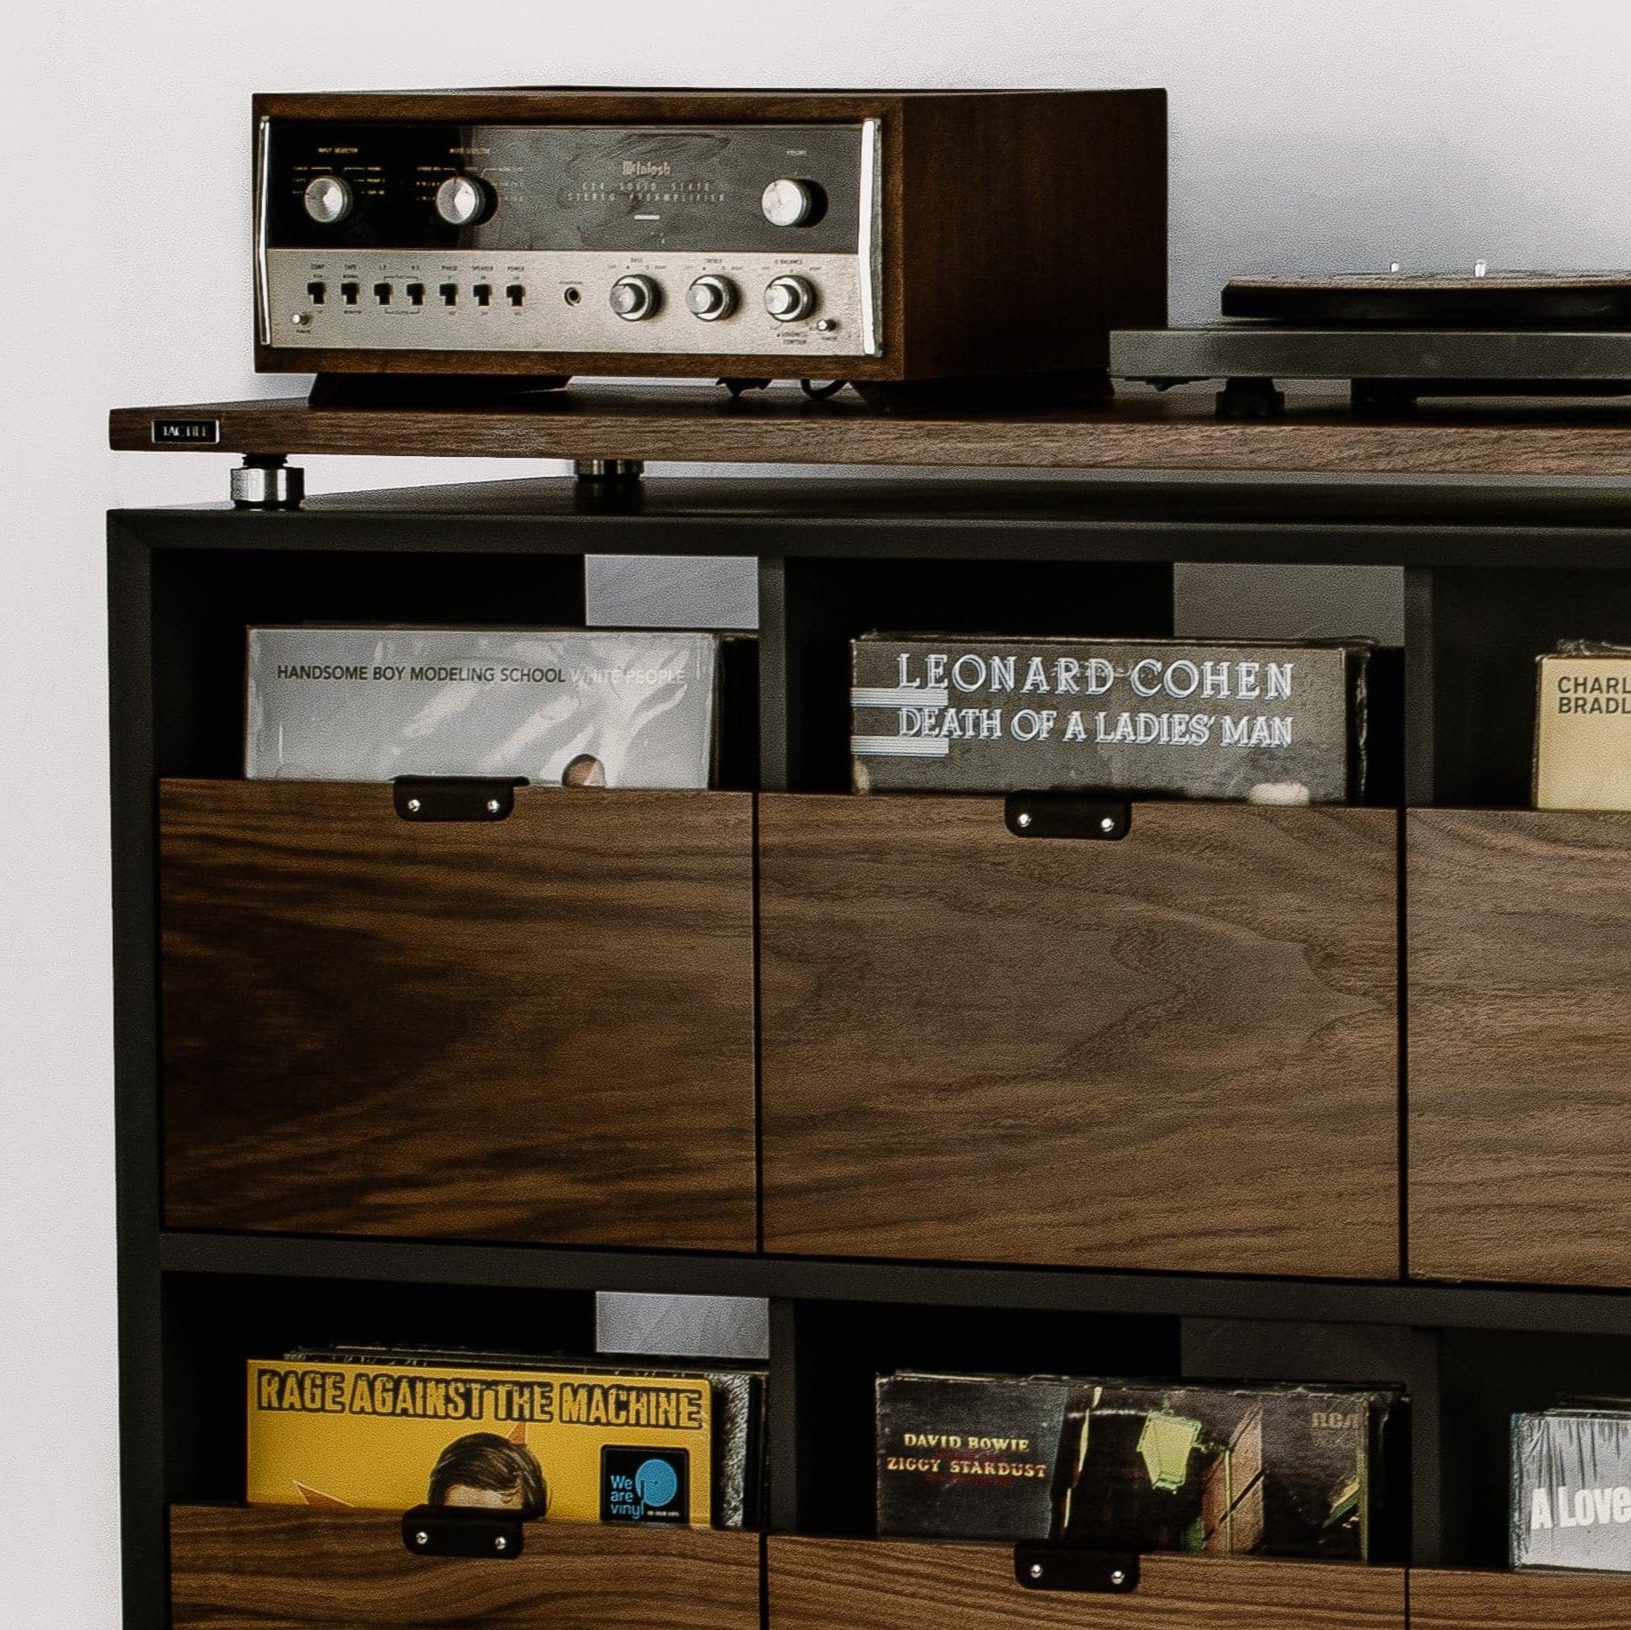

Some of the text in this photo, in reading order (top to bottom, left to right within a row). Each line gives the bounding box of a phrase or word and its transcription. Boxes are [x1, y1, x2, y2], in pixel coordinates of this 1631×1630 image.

[277, 664, 368, 681] HANDSOME
[373, 665, 406, 681] BOY
[410, 667, 495, 682] MODELING
[500, 667, 566, 683] SCHOOL
[897, 652, 1115, 695] LEONARD
[1130, 658, 1296, 701] COHEN
[898, 706, 1002, 740] DEATH
[1010, 709, 1056, 742] OF
[1063, 711, 1088, 742] A
[1220, 715, 1294, 748] MAN
[257, 1369, 703, 1430] RAGE AGAINST THE MACHINE
[904, 1433, 1030, 1453] DAVID BOWIE
[887, 1457, 1047, 1478] ZIGGY STARDUST
[610, 1474, 633, 1490] We
[610, 1490, 634, 1502] are
[610, 1499, 645, 1520] vinyl
[1530, 1487, 1552, 1530] A
[1558, 1486, 1631, 1528] Love
